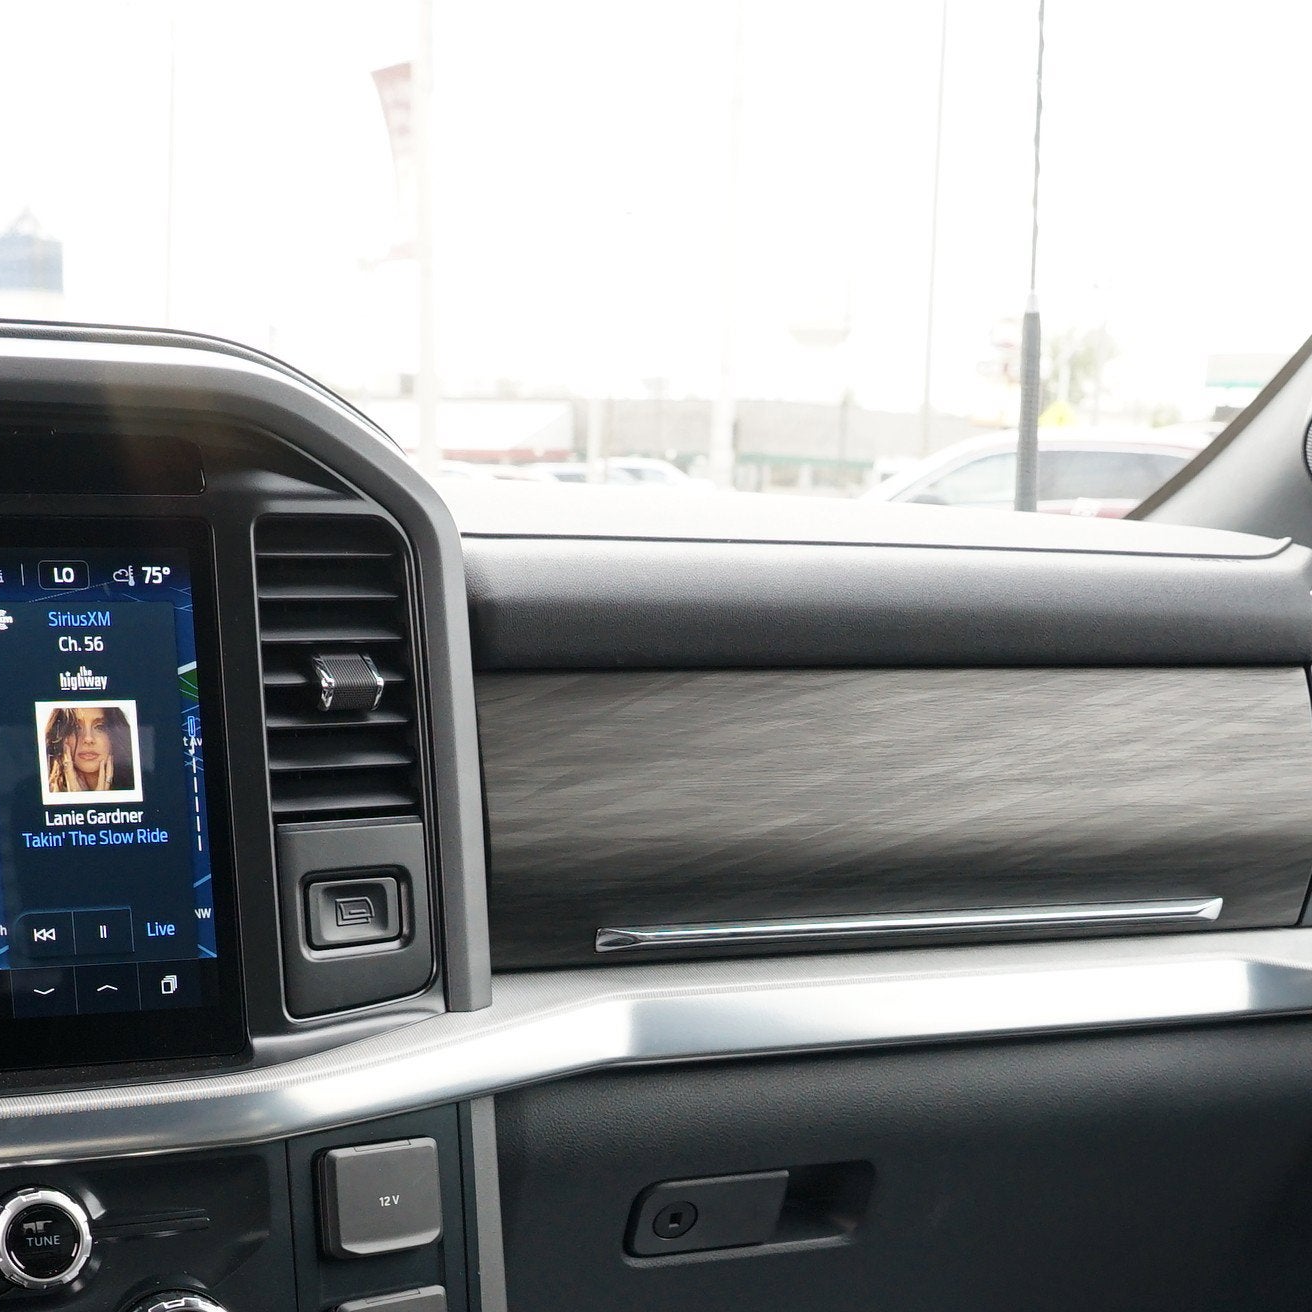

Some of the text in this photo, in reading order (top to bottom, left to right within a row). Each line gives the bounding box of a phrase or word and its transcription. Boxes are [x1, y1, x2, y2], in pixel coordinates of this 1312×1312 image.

[53, 567, 75, 583] LO
[141, 566, 171, 584] 75°
[48, 611, 111, 627] SiriusXM
[58, 636, 104, 651] Ch. 56
[59, 671, 108, 691] highway
[45, 808, 144, 827] Lanie Gardner
[21, 828, 169, 848] Takin' The Slow Ride
[147, 921, 176, 937] Live
[378, 1194, 401, 1207] 12 V
[26, 1232, 61, 1248] TUNE
